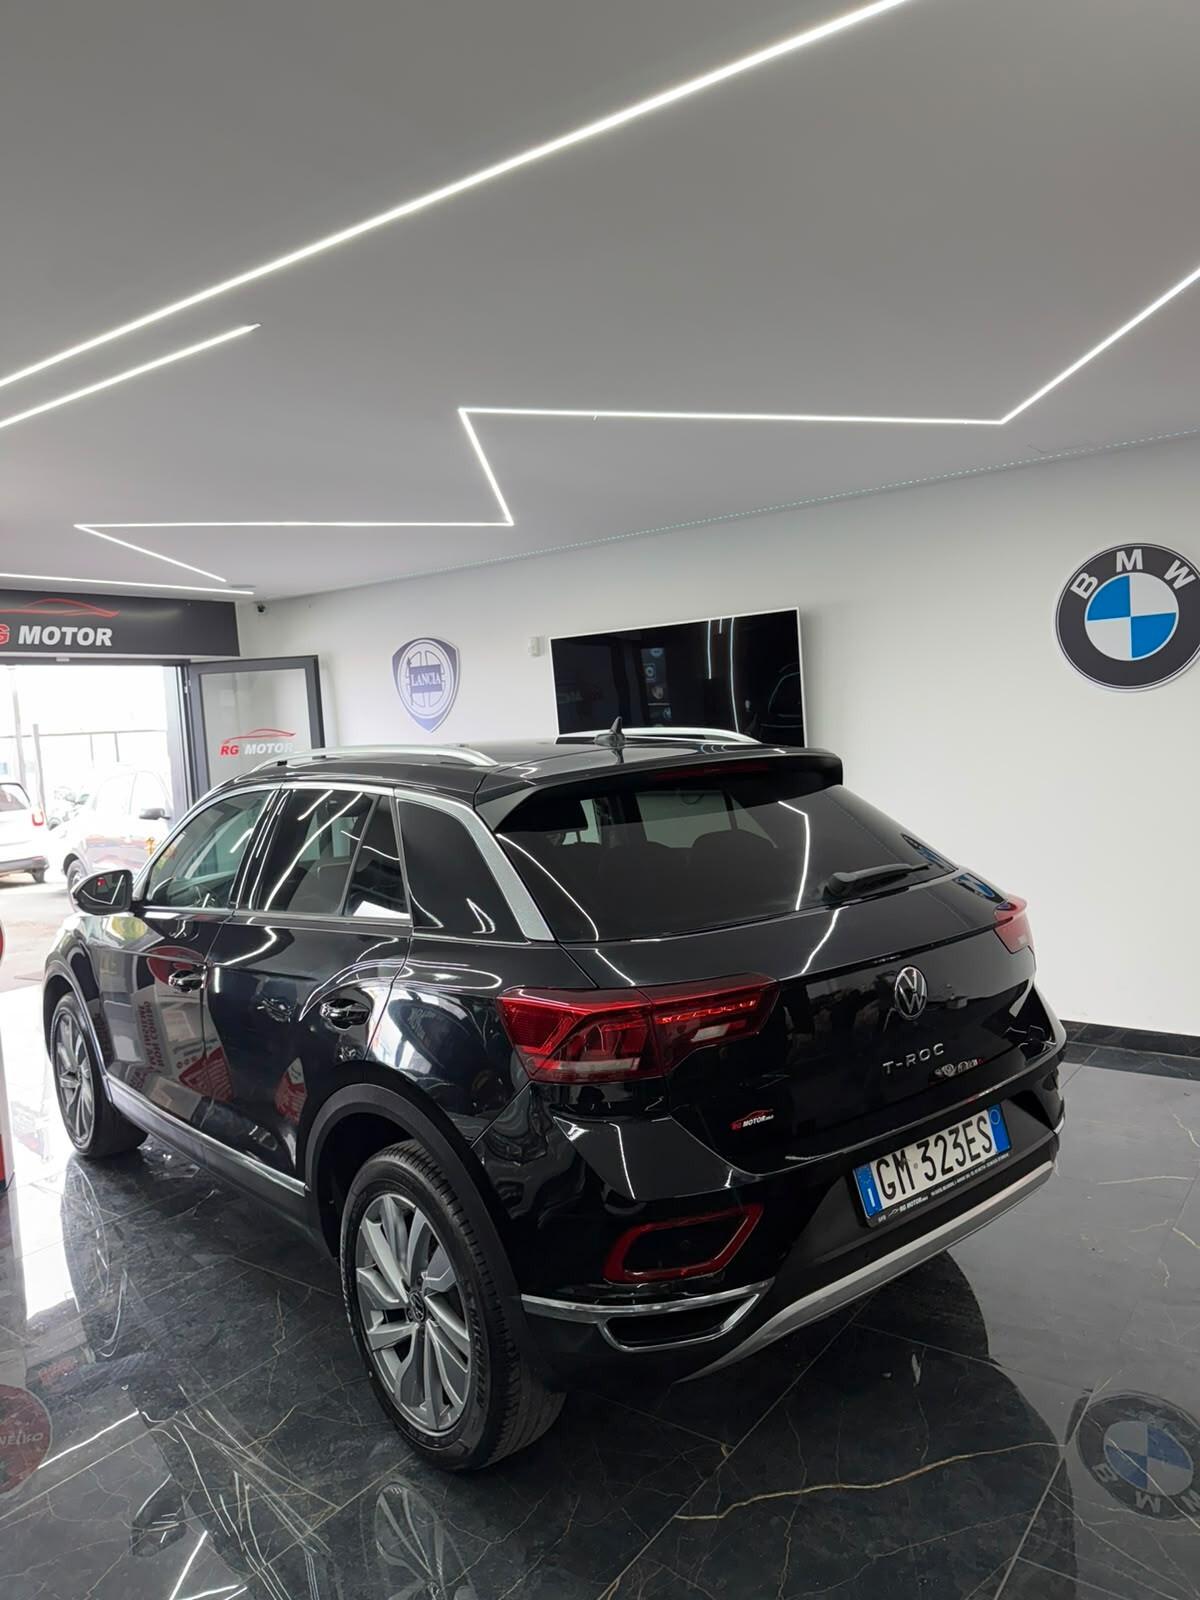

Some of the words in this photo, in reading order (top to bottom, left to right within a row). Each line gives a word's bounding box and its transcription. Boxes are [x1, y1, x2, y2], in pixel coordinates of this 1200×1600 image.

[1069, 548, 1197, 600] BMW
[18, 625, 113, 647] MOTOR
[411, 671, 442, 687] LANCIA
[220, 745, 239, 756] RG
[244, 742, 294, 755] MOTOR
[882, 1043, 945, 1074] T-ROC
[876, 1149, 915, 1200] GM
[916, 1115, 993, 1182] 323ES
